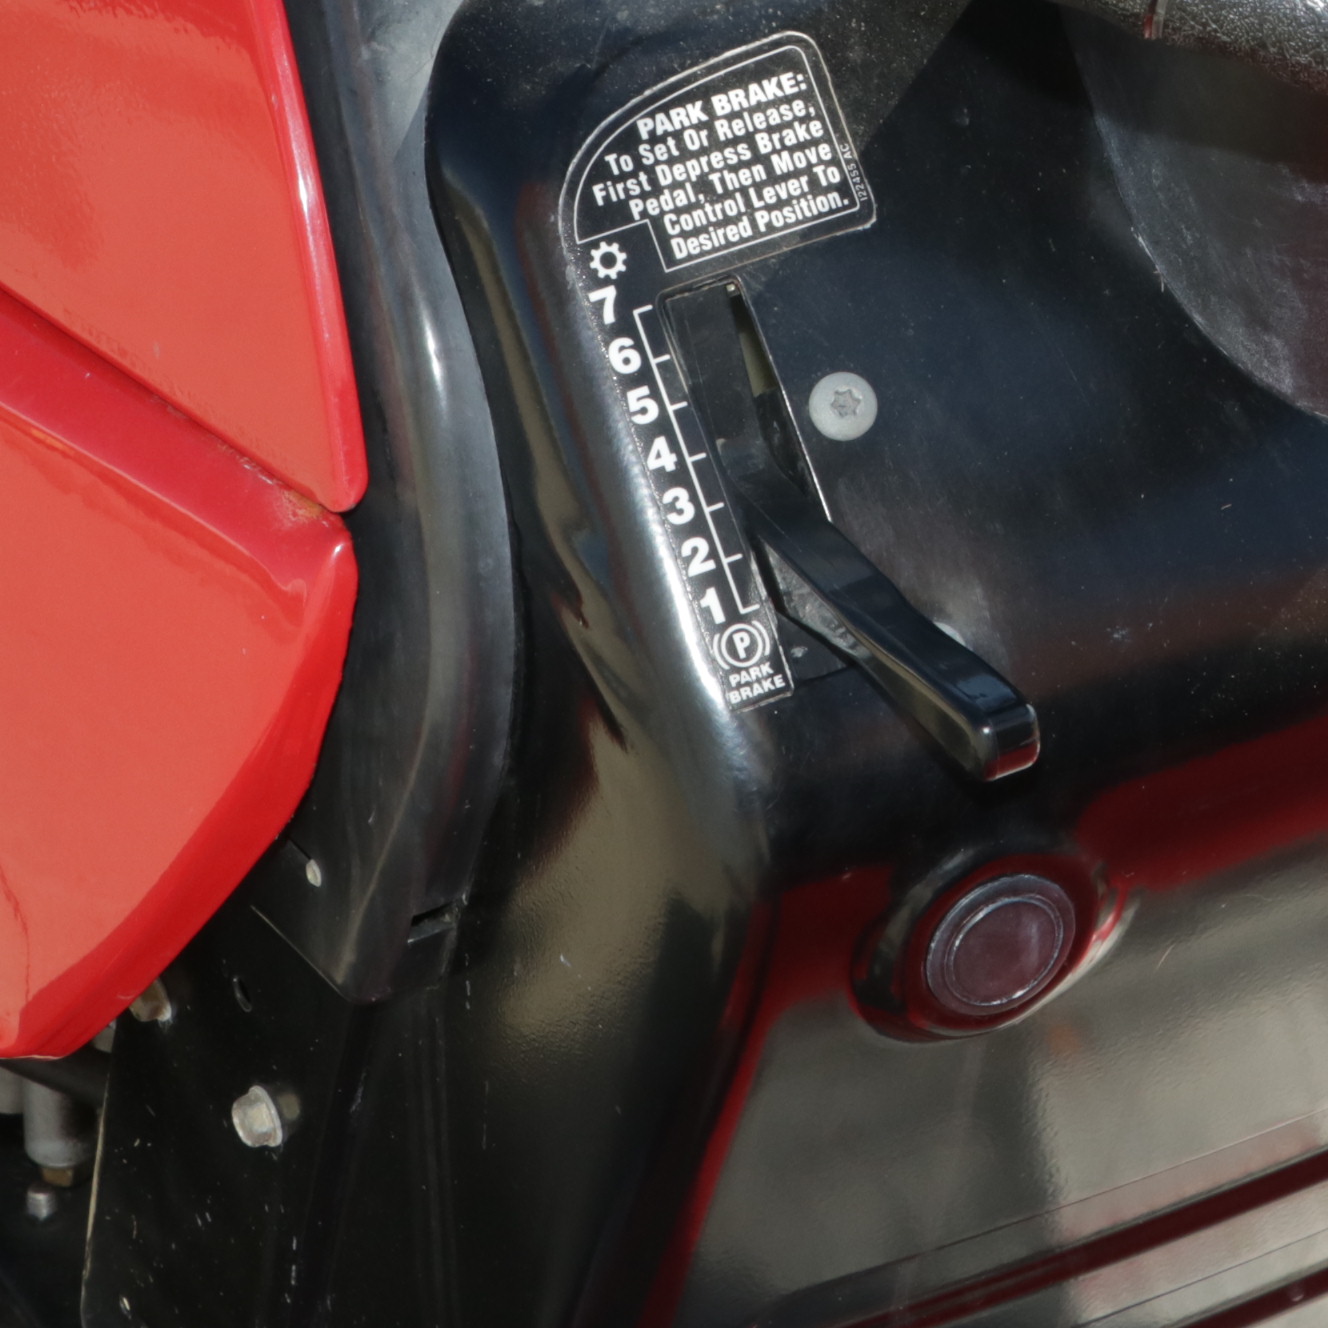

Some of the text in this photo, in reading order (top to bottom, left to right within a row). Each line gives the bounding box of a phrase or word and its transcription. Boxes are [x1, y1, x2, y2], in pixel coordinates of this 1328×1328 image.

[637, 72, 807, 140] PARK BRAKE:
[604, 99, 815, 176] To Set Or Release,
[592, 120, 823, 206] First Depress Brake
[629, 143, 832, 220] Pedal, Then Move
[840, 143, 868, 201] 122455 AC
[664, 165, 841, 235] Control Lever To
[670, 191, 849, 260] Desired Position.
[588, 285, 617, 325] 7
[608, 337, 641, 374] 6
[627, 385, 659, 425] 5
[647, 436, 677, 472] 4
[662, 487, 696, 525] 3
[681, 537, 716, 578] 2
[700, 587, 726, 624] 1
[729, 661, 775, 688] PARK
[729, 674, 786, 704] BRAKE
